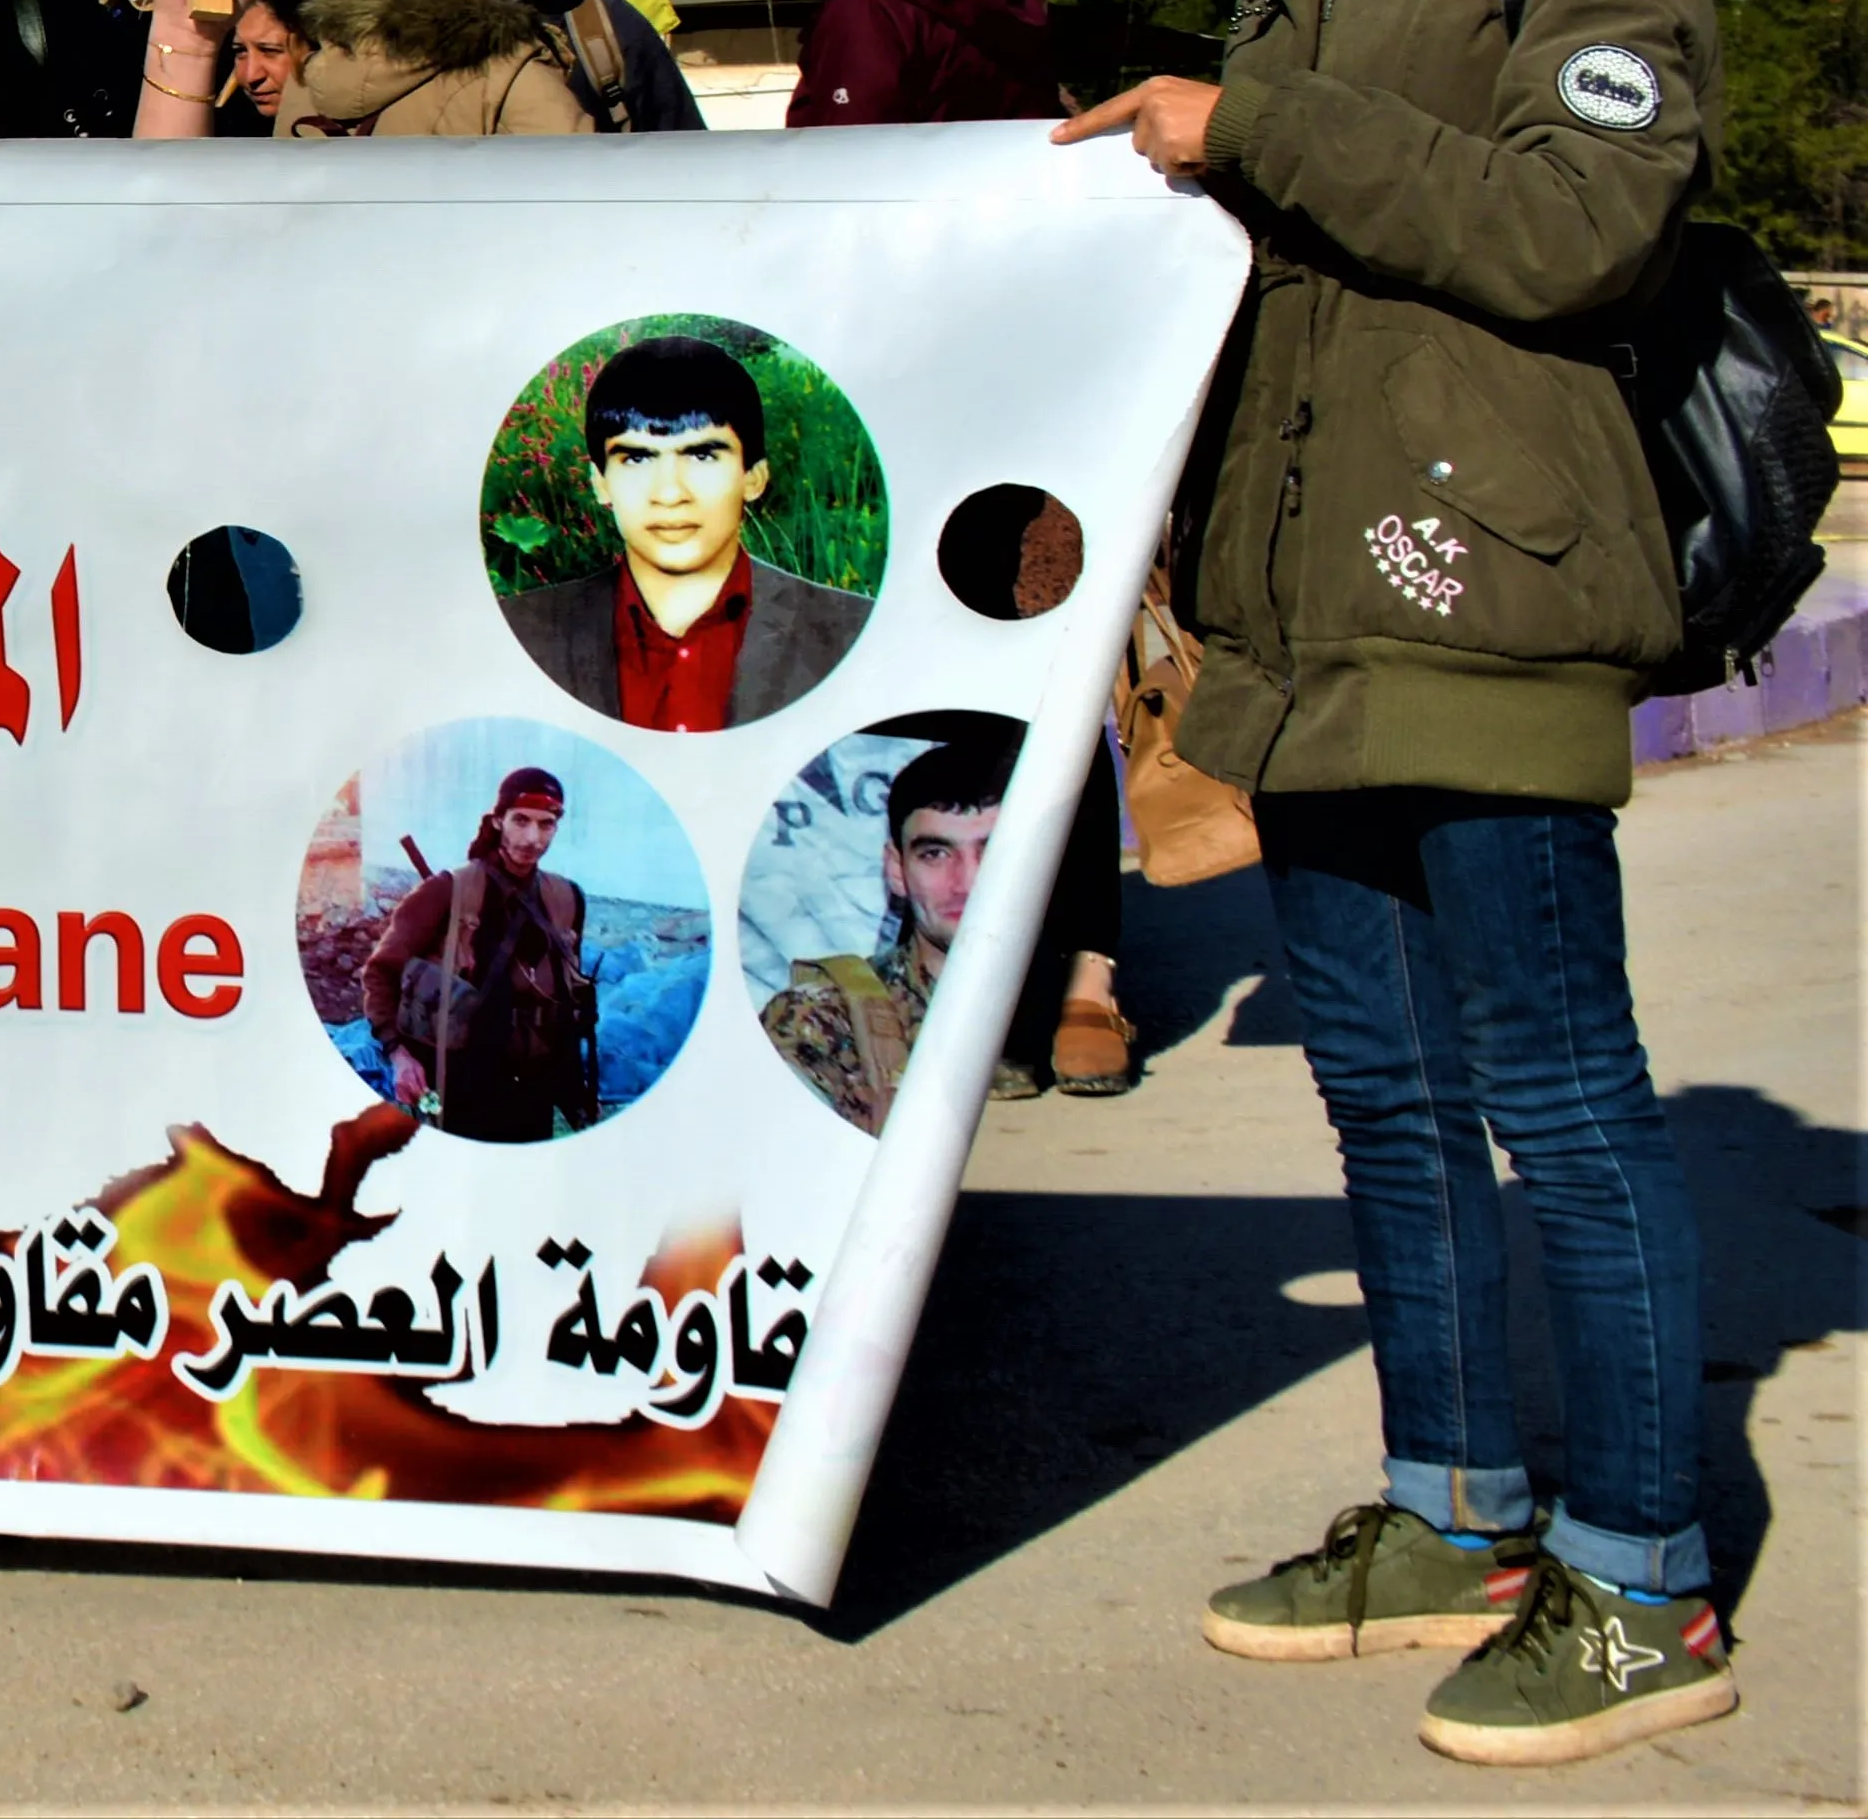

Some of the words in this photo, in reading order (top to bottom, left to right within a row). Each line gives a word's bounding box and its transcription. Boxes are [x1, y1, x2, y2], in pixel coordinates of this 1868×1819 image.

[1377, 514, 1465, 607] OSCAR
[1411, 517, 1469, 564] A.K
[183, 1249, 500, 1390] العصر
[536, 1236, 815, 1419] قاومة
